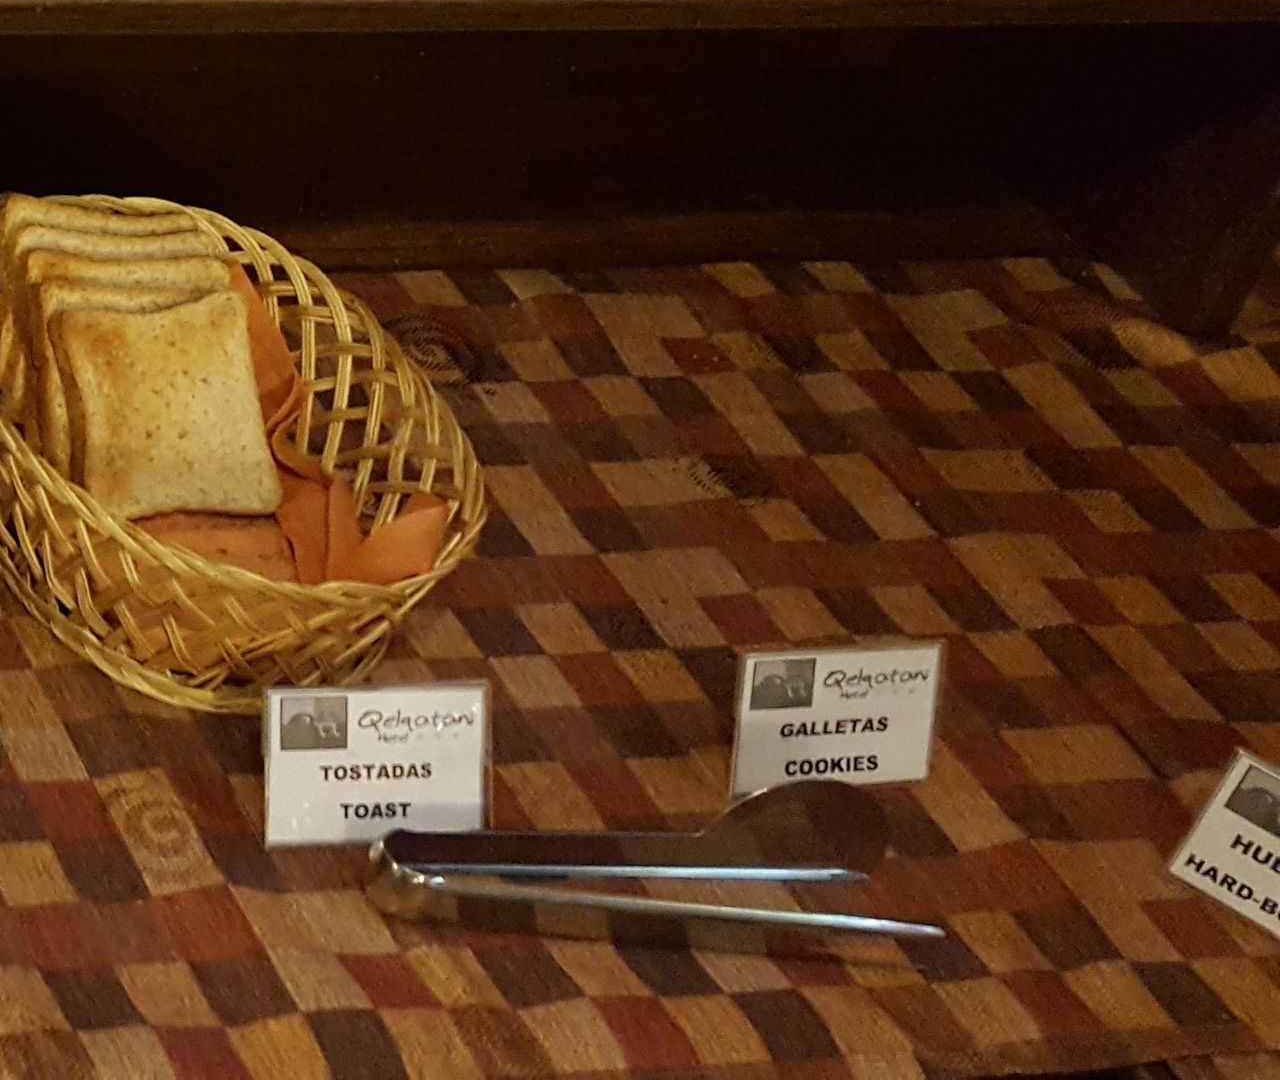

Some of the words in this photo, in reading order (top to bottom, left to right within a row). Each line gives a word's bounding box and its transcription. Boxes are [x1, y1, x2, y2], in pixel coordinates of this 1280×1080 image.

[779, 717, 889, 738] GALLETAS
[320, 763, 432, 781] TOSTADAS
[784, 756, 879, 776] COOKIES
[340, 803, 412, 819] TOAST
[1185, 853, 1280, 920] HARD-B
